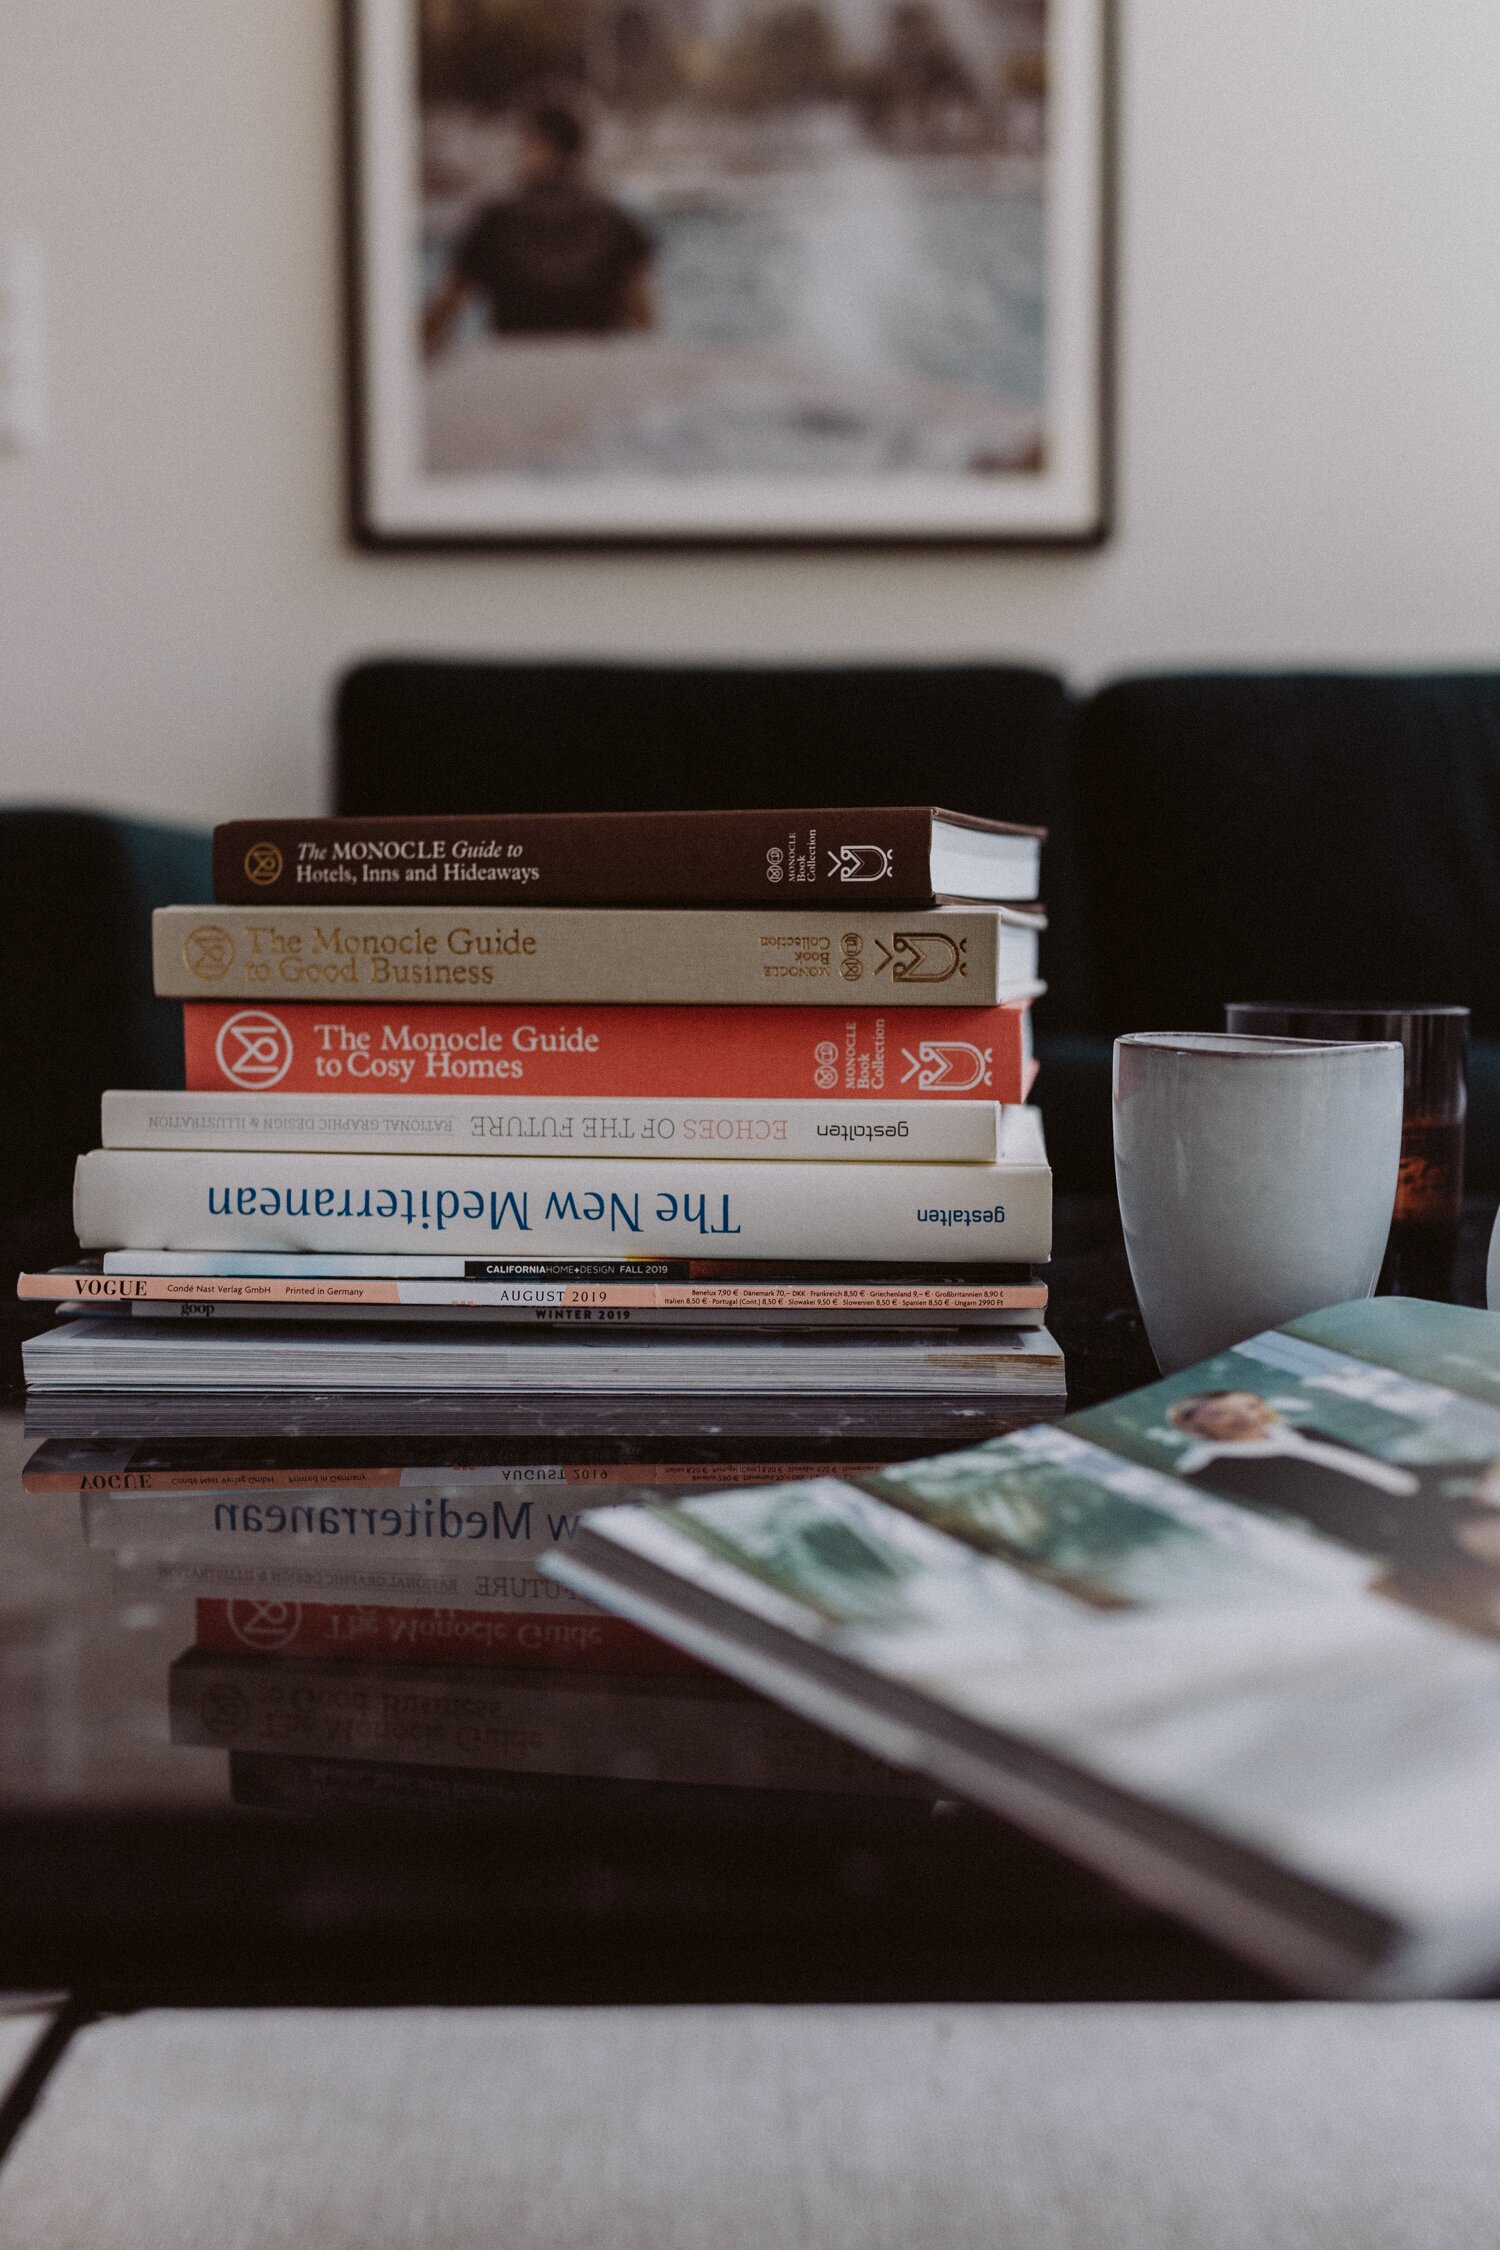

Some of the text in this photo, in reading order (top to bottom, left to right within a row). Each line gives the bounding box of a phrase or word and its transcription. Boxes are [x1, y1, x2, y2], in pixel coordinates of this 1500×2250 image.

[298, 840, 523, 861] The MONOCLE Guide to
[788, 832, 796, 882] MONOCLE
[807, 828, 817, 882] Collection
[296, 863, 540, 885] Hotels, Inns and Hideaways
[797, 854, 806, 882] Book
[244, 927, 537, 955] The Monocle Guide
[760, 936, 831, 950] Collection
[795, 952, 831, 964] Book
[244, 956, 495, 985] to Good Business
[763, 966, 831, 977] MONOCLE
[314, 1024, 600, 1053] The Monocle Guide
[845, 1022, 857, 1089] MONOCLE
[871, 1018, 885, 1090] Collection
[315, 1051, 524, 1083] to Cosy Homes
[857, 1053, 870, 1089] Book
[149, 1115, 454, 1133] RATIONAL GRAPHIC DESIGN & ILLUSTRATION
[471, 1115, 788, 1140] ECHOES OF THE FUTURE
[816, 1121, 909, 1141] gestalten
[208, 1187, 741, 1235] The New Mediterranean
[916, 1206, 1005, 1227] gestalten
[619, 1265, 643, 1274] FALL
[645, 1265, 668, 1274] 2019
[75, 1279, 147, 1296] VOGUE
[167, 1283, 271, 1295] Condé Nast Verlag GmbH
[285, 1286, 364, 1297] Printed in Germany
[500, 1290, 607, 1302] AUGUST 2019
[718, 1289, 732, 1297] 7,90
[935, 1290, 982, 1298] Großbritannien
[181, 1301, 215, 1316] goop
[712, 1298, 738, 1306] Portugal
[902, 1299, 927, 1307] Spanien
[536, 1309, 631, 1320] WINTER 2019
